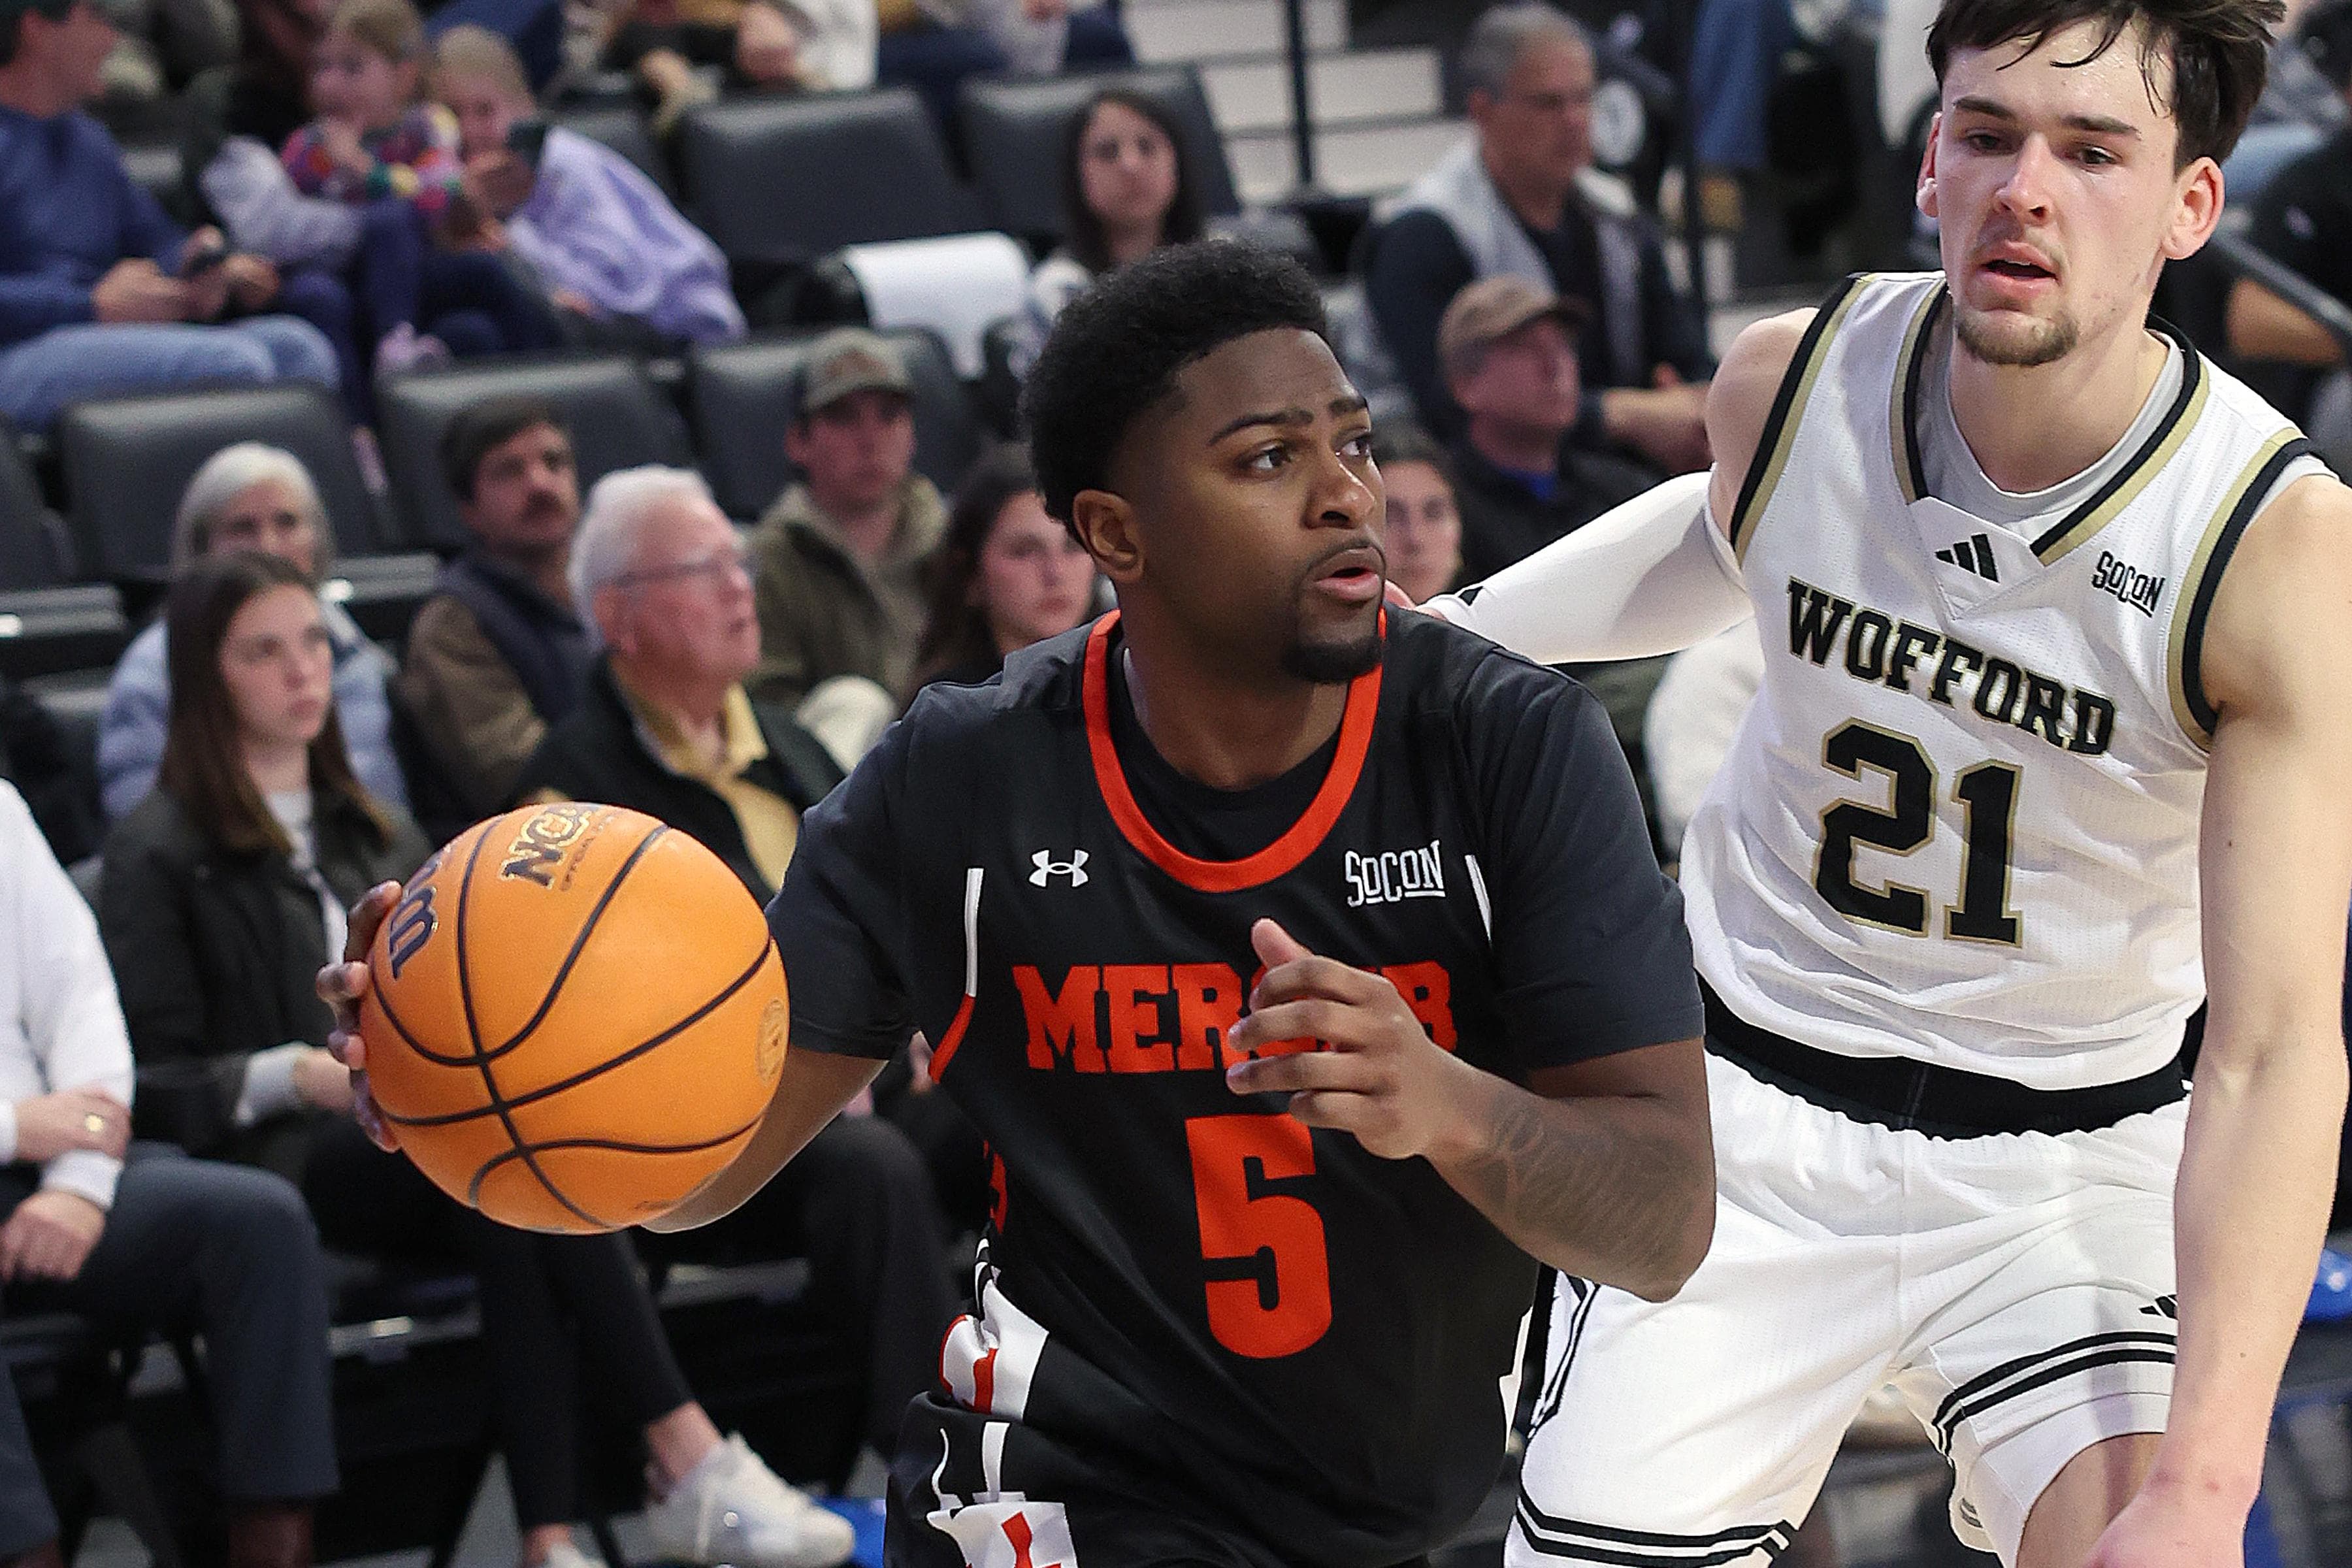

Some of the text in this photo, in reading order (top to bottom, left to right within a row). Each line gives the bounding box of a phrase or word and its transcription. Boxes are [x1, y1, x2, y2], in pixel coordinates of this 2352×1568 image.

[1787, 576, 2117, 759] WOFFORD
[1816, 717, 2023, 949] 21
[1185, 1113, 1333, 1360] 5
